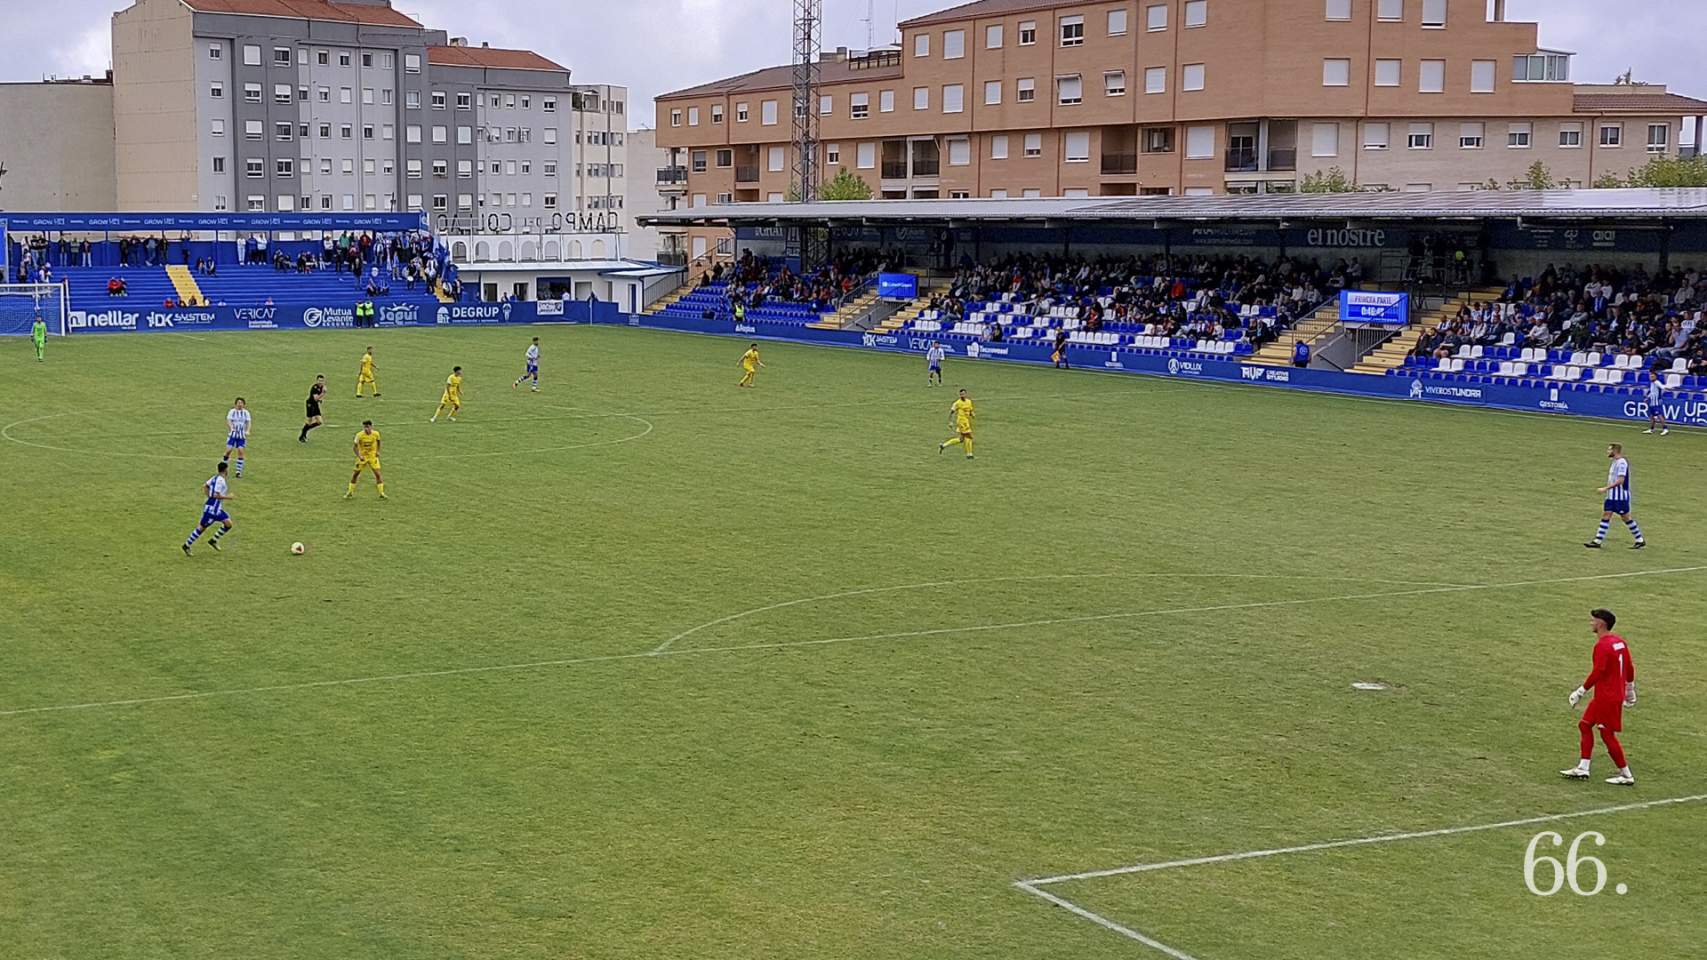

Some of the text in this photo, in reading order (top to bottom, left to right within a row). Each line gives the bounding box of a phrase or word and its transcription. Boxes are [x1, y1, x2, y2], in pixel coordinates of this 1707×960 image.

[1307, 228, 1385, 247] el nostre
[233, 308, 277, 319] VERICAT
[322, 307, 352, 316] Mutua
[452, 306, 499, 318] DEGRUP
[173, 313, 215, 322] SYSTEM
[322, 314, 354, 323] Levante
[1623, 401, 1707, 420] GRW UP
[1618, 653, 1624, 677] 1
